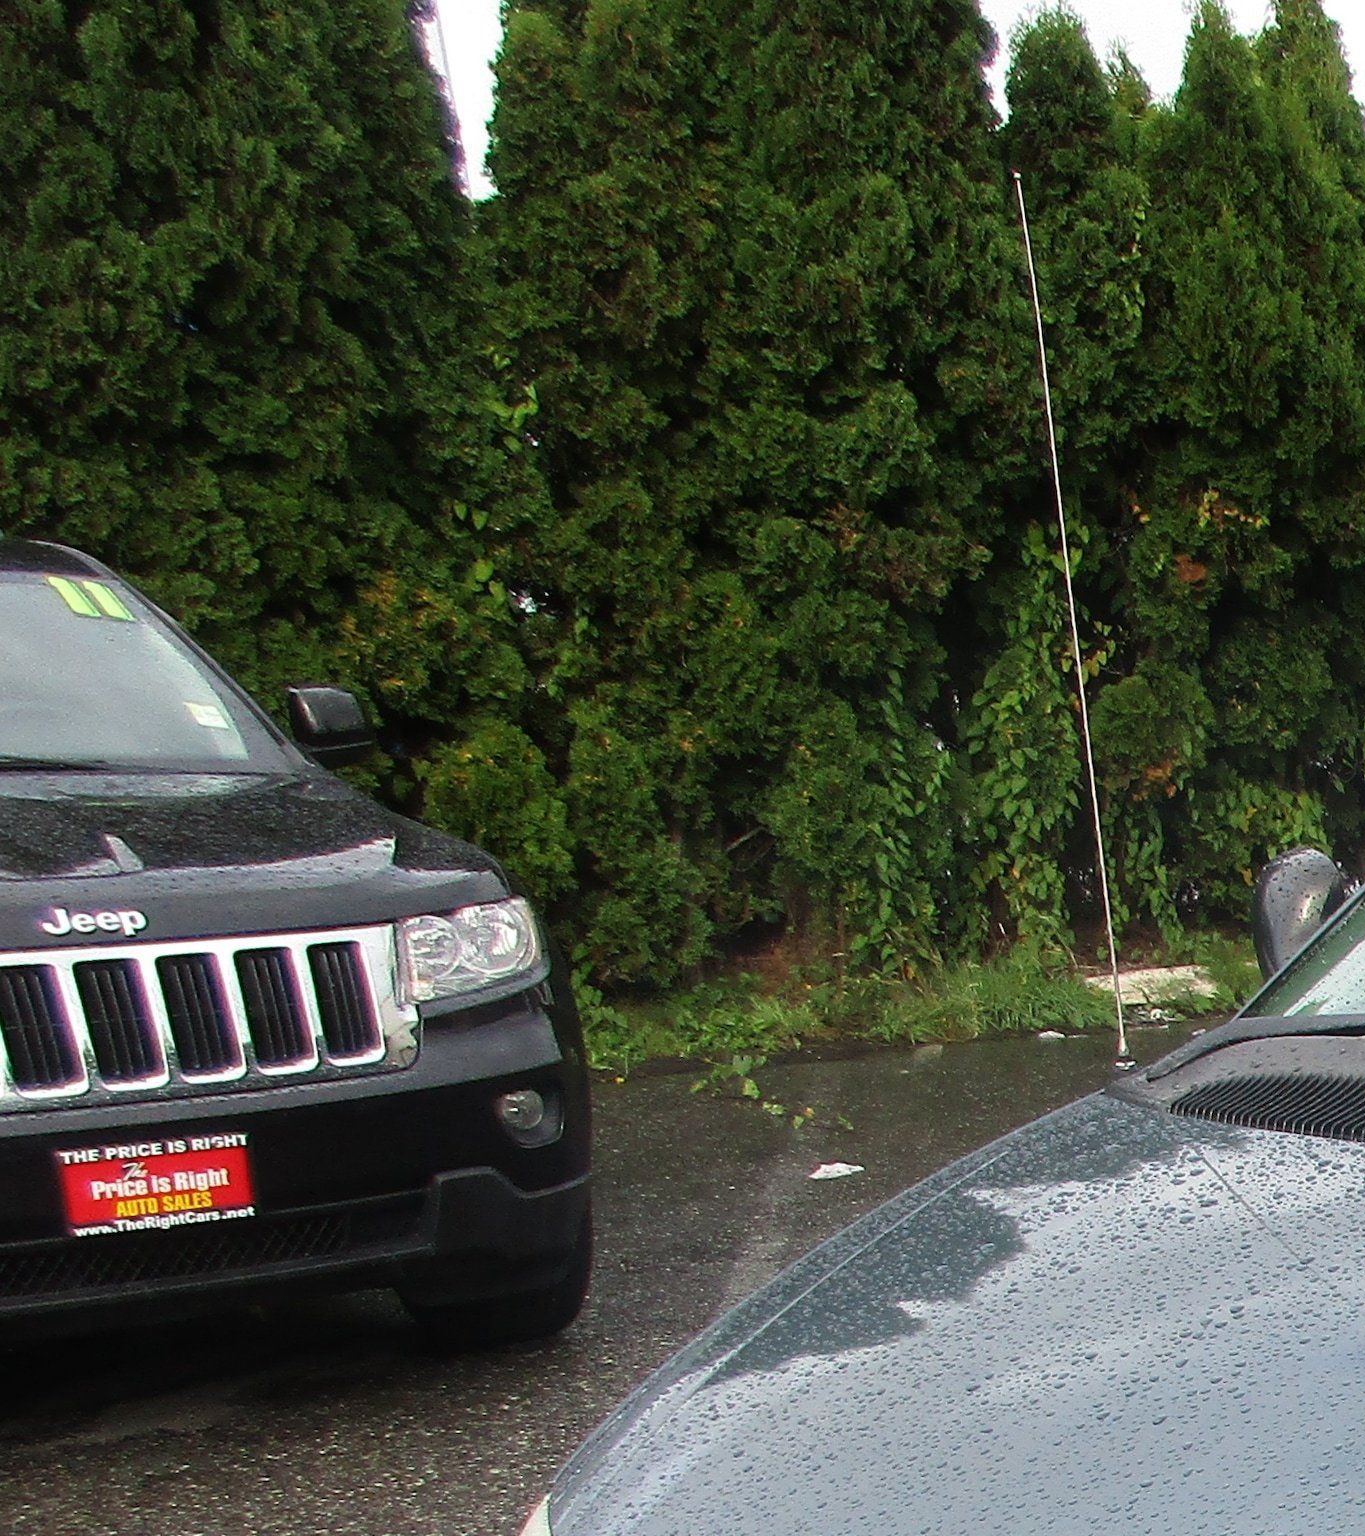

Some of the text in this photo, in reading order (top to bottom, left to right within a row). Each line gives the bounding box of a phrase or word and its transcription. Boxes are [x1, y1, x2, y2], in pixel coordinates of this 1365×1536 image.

[47, 575, 138, 621] 11
[41, 907, 148, 937] Jeep
[59, 1134, 248, 1164] THE PRICE IS RIGHT
[90, 1168, 230, 1200] Price is Right
[122, 1162, 149, 1180] The
[116, 1192, 212, 1217] AUTO SALES
